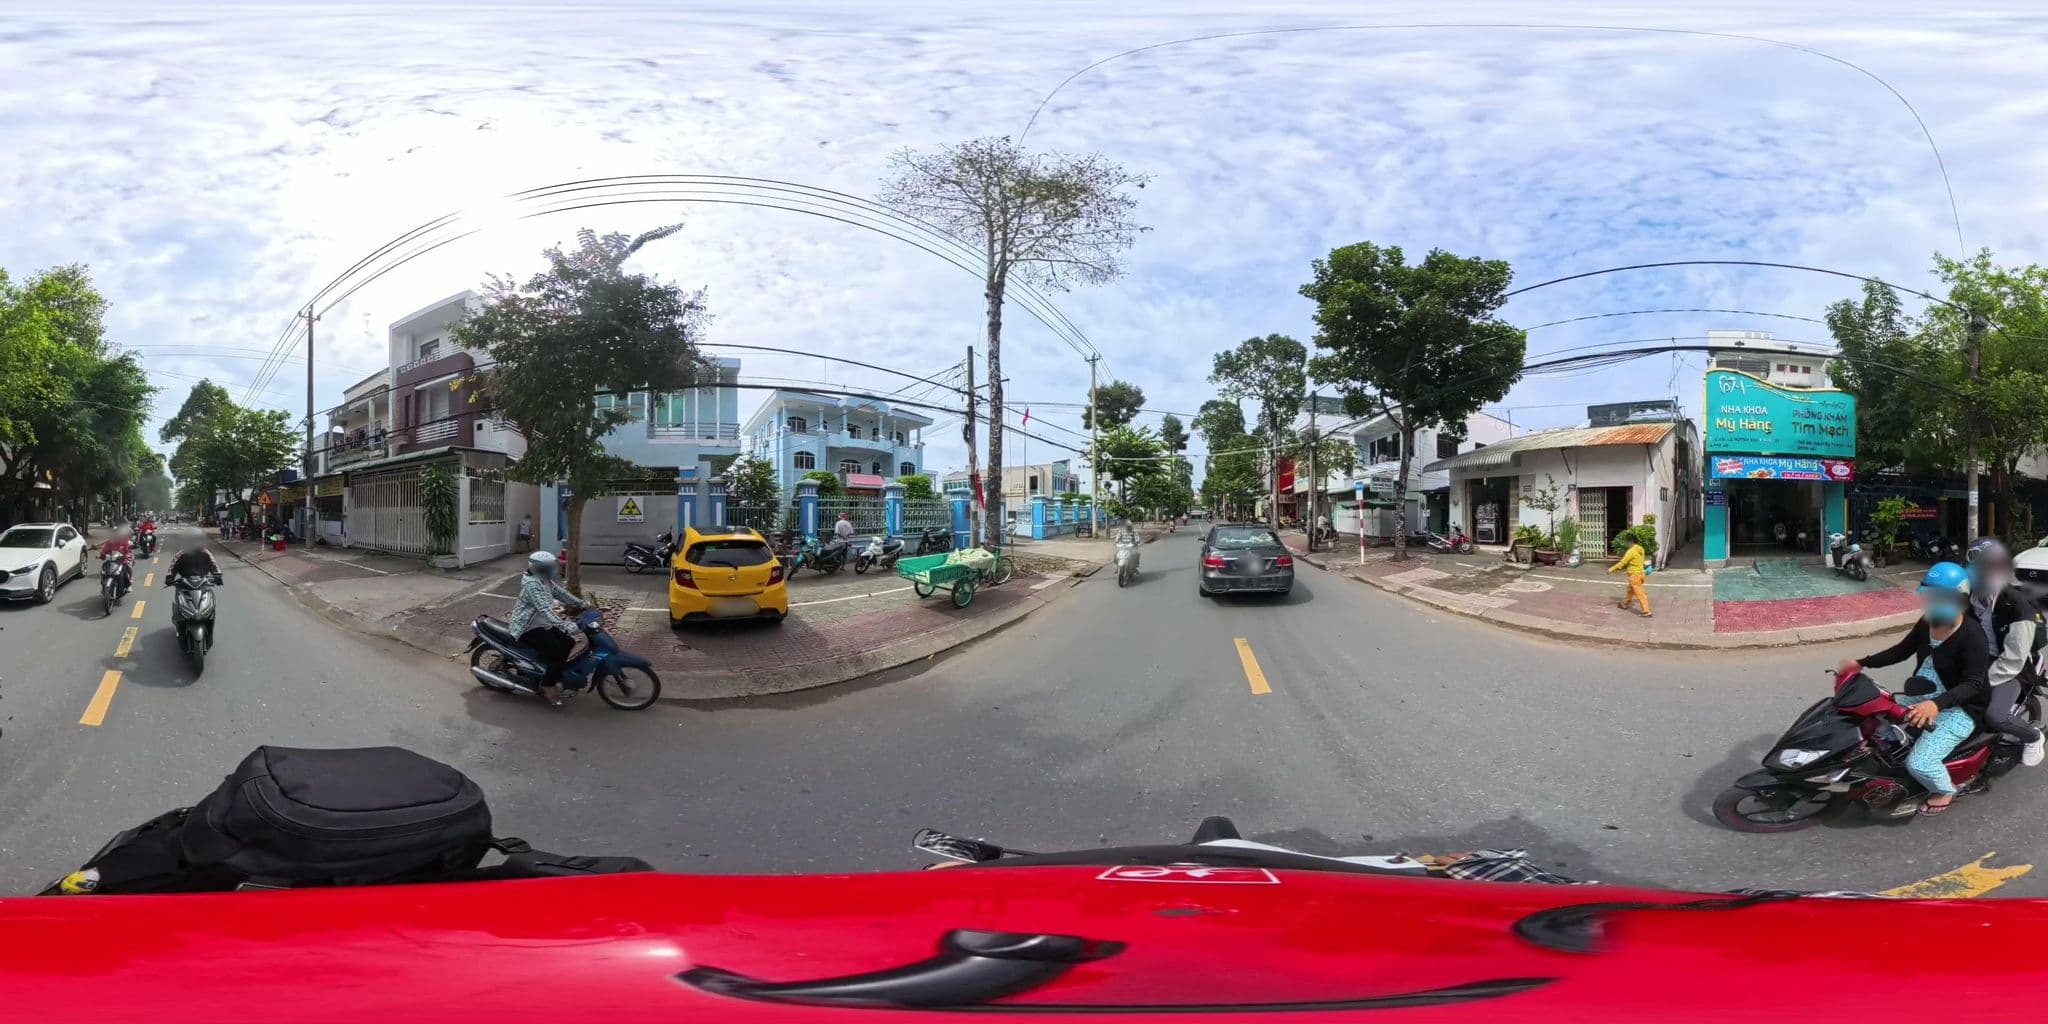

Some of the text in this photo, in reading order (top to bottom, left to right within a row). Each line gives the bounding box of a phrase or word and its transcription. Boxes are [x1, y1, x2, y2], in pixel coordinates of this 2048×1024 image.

[1720, 405, 1768, 415] NHA KHOA
[1792, 421, 1849, 438] Tim Mạch
[1759, 458, 1778, 466] KHOA
